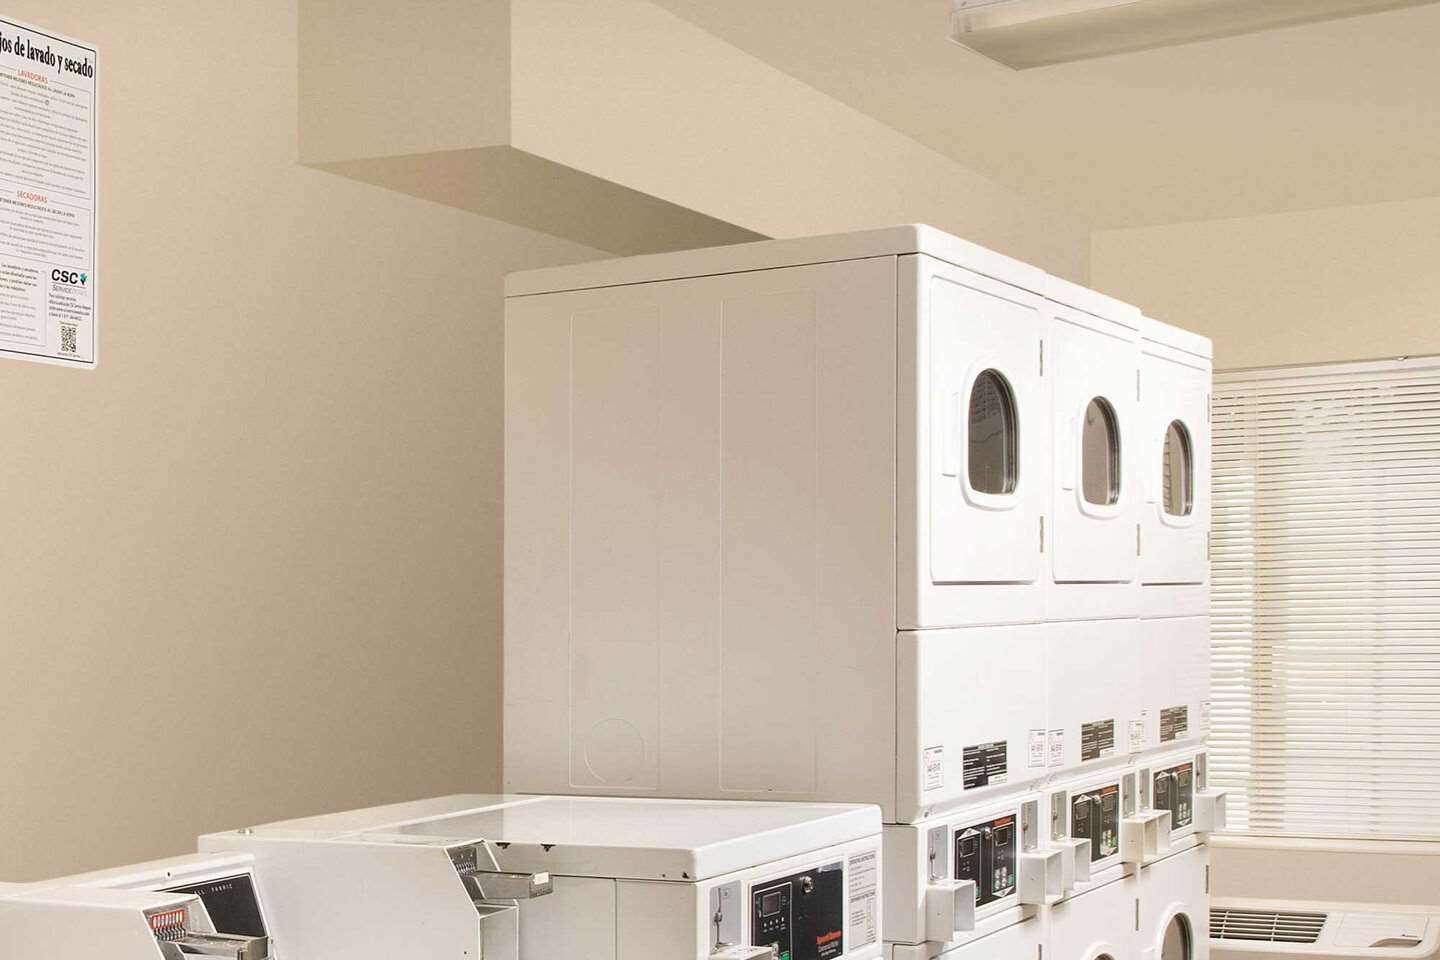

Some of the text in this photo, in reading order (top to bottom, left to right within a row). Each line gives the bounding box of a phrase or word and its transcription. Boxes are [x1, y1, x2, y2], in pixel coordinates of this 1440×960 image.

[14, 36, 24, 57] de
[27, 40, 55, 66] lavado
[58, 55, 63, 74] y
[65, 56, 93, 78] secado
[17, 191, 47, 203] SECADORAS
[51, 269, 78, 284] CSC
